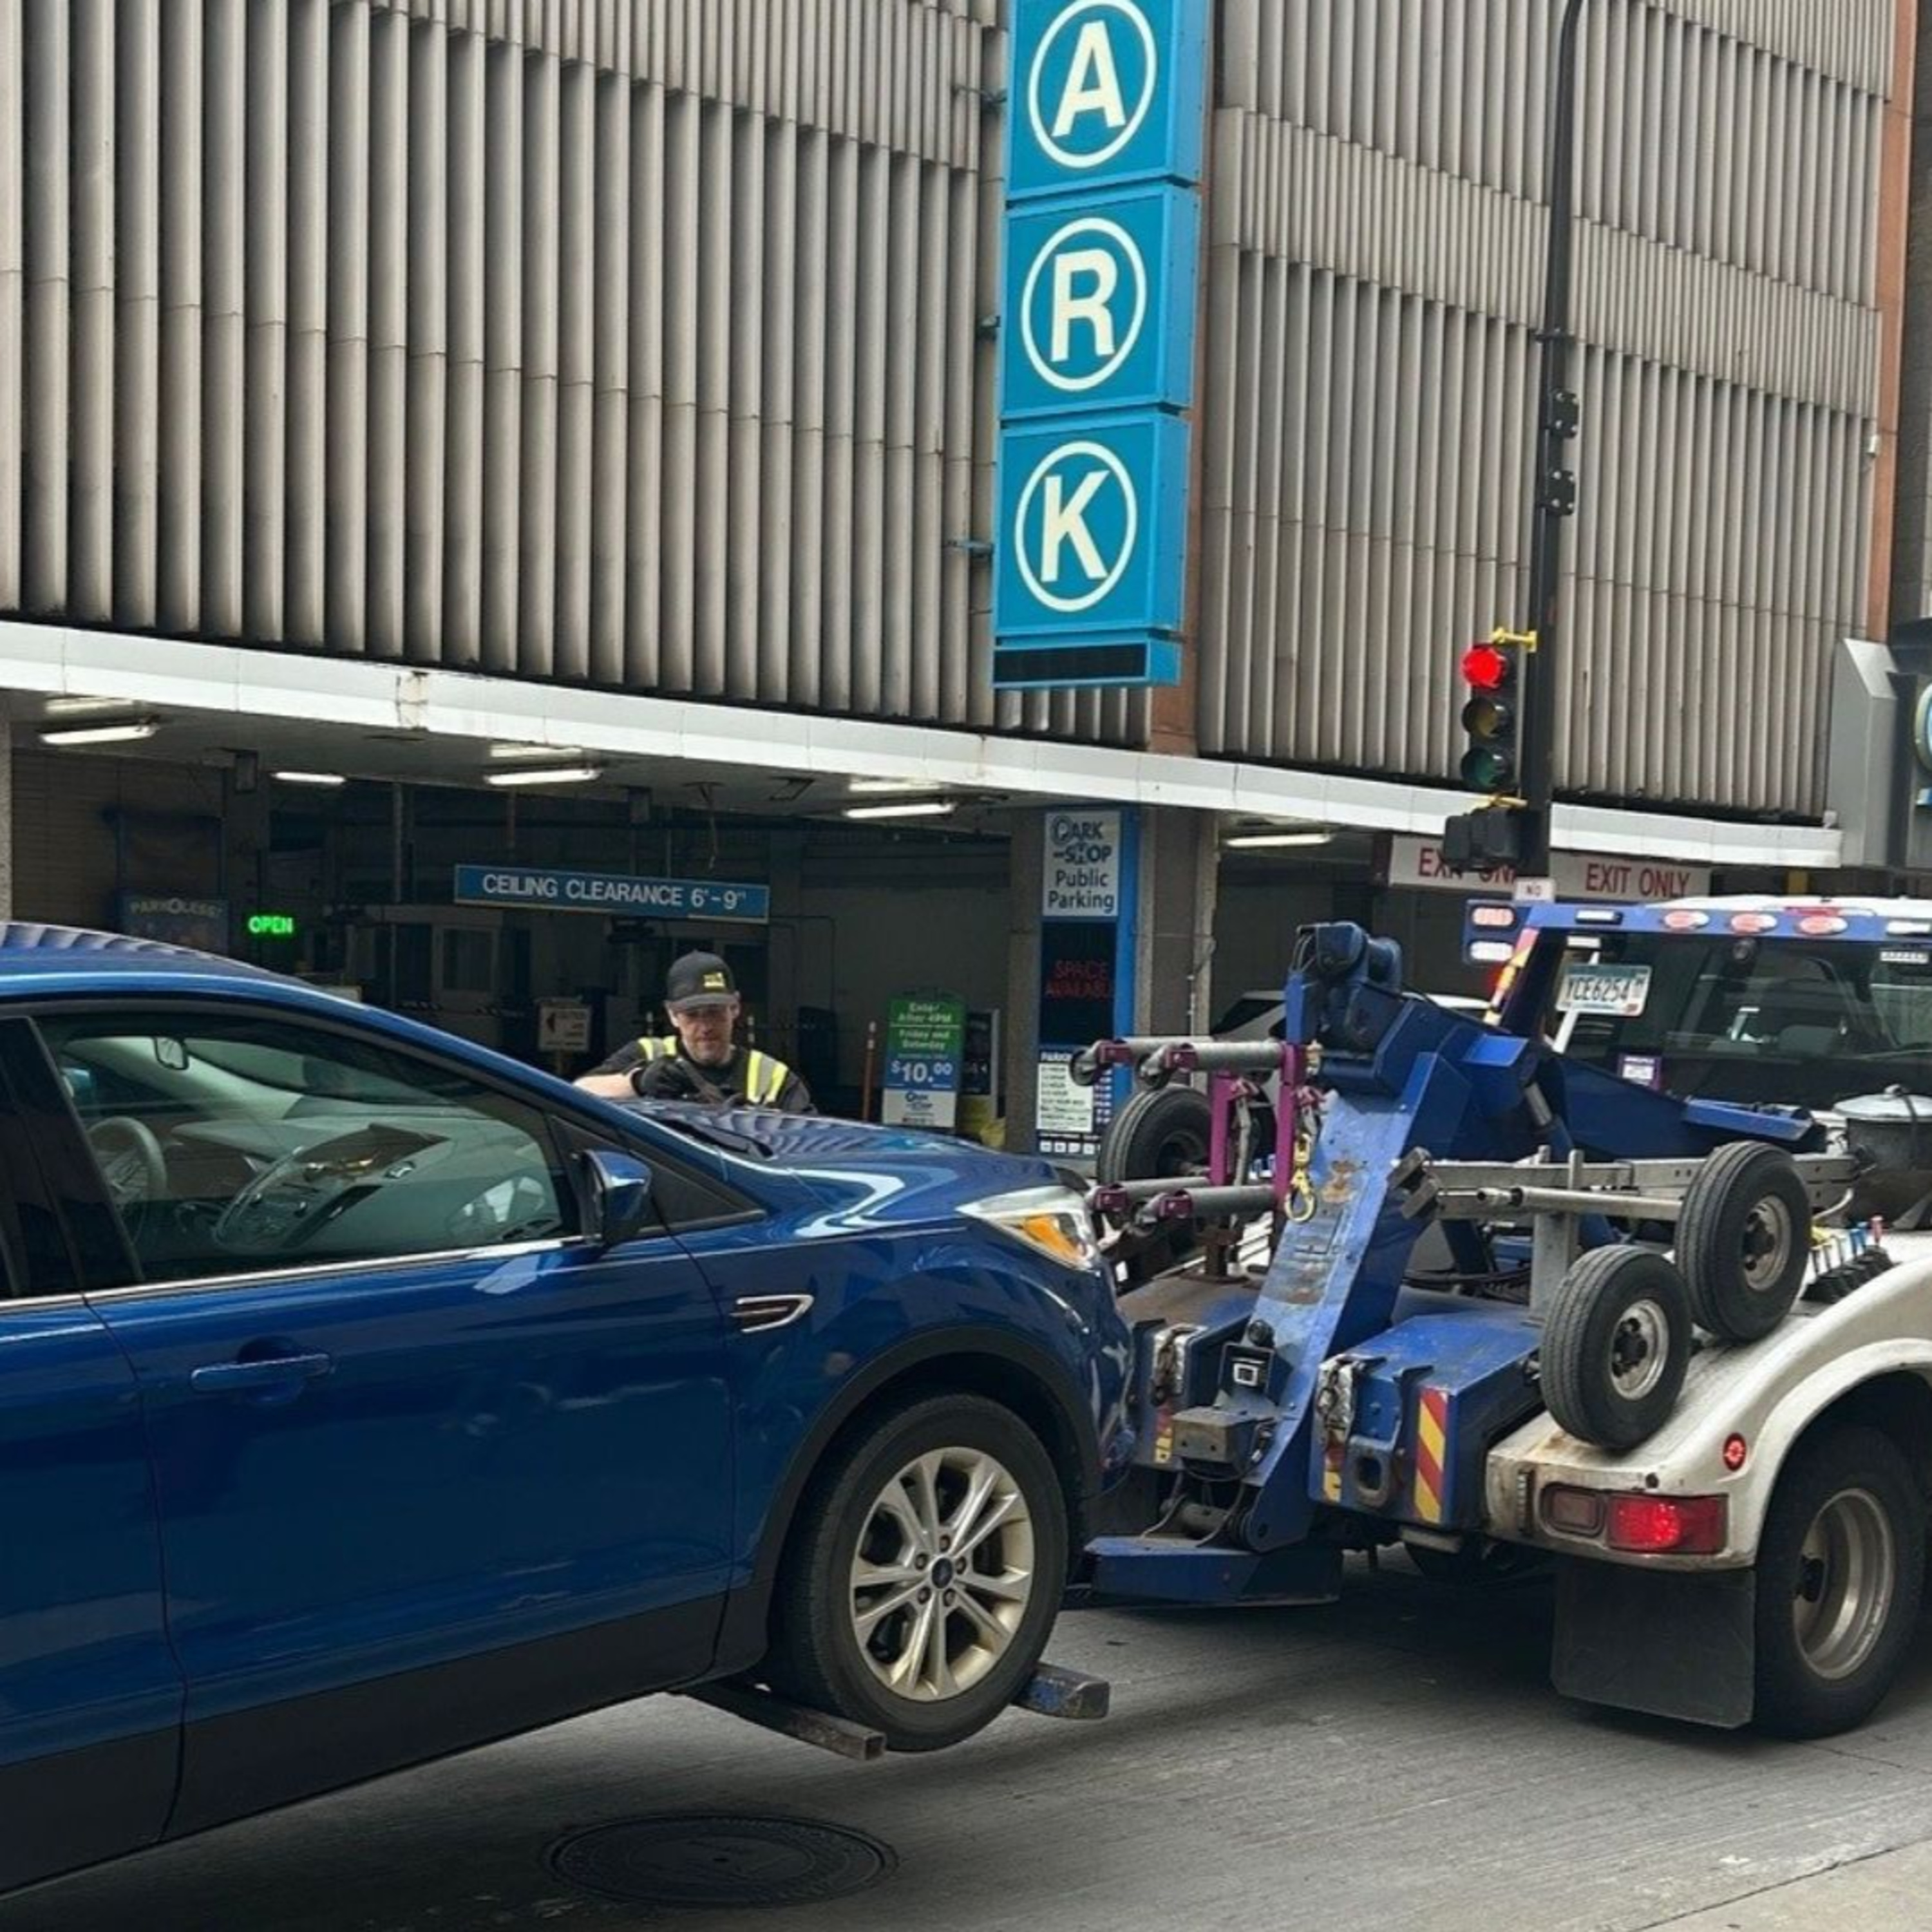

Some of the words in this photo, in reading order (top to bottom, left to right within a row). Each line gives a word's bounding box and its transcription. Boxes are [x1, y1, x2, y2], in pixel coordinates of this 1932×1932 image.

[1056, 868, 1108, 887] Public
[1586, 863, 1631, 894] EXIT
[1639, 867, 1690, 899] ONLY
[482, 874, 558, 898] CEILING
[565, 880, 683, 906] CLEARANCE
[1048, 890, 1115, 914] Parking
[249, 915, 293, 933] OPEN
[891, 1060, 952, 1083] $10.00
